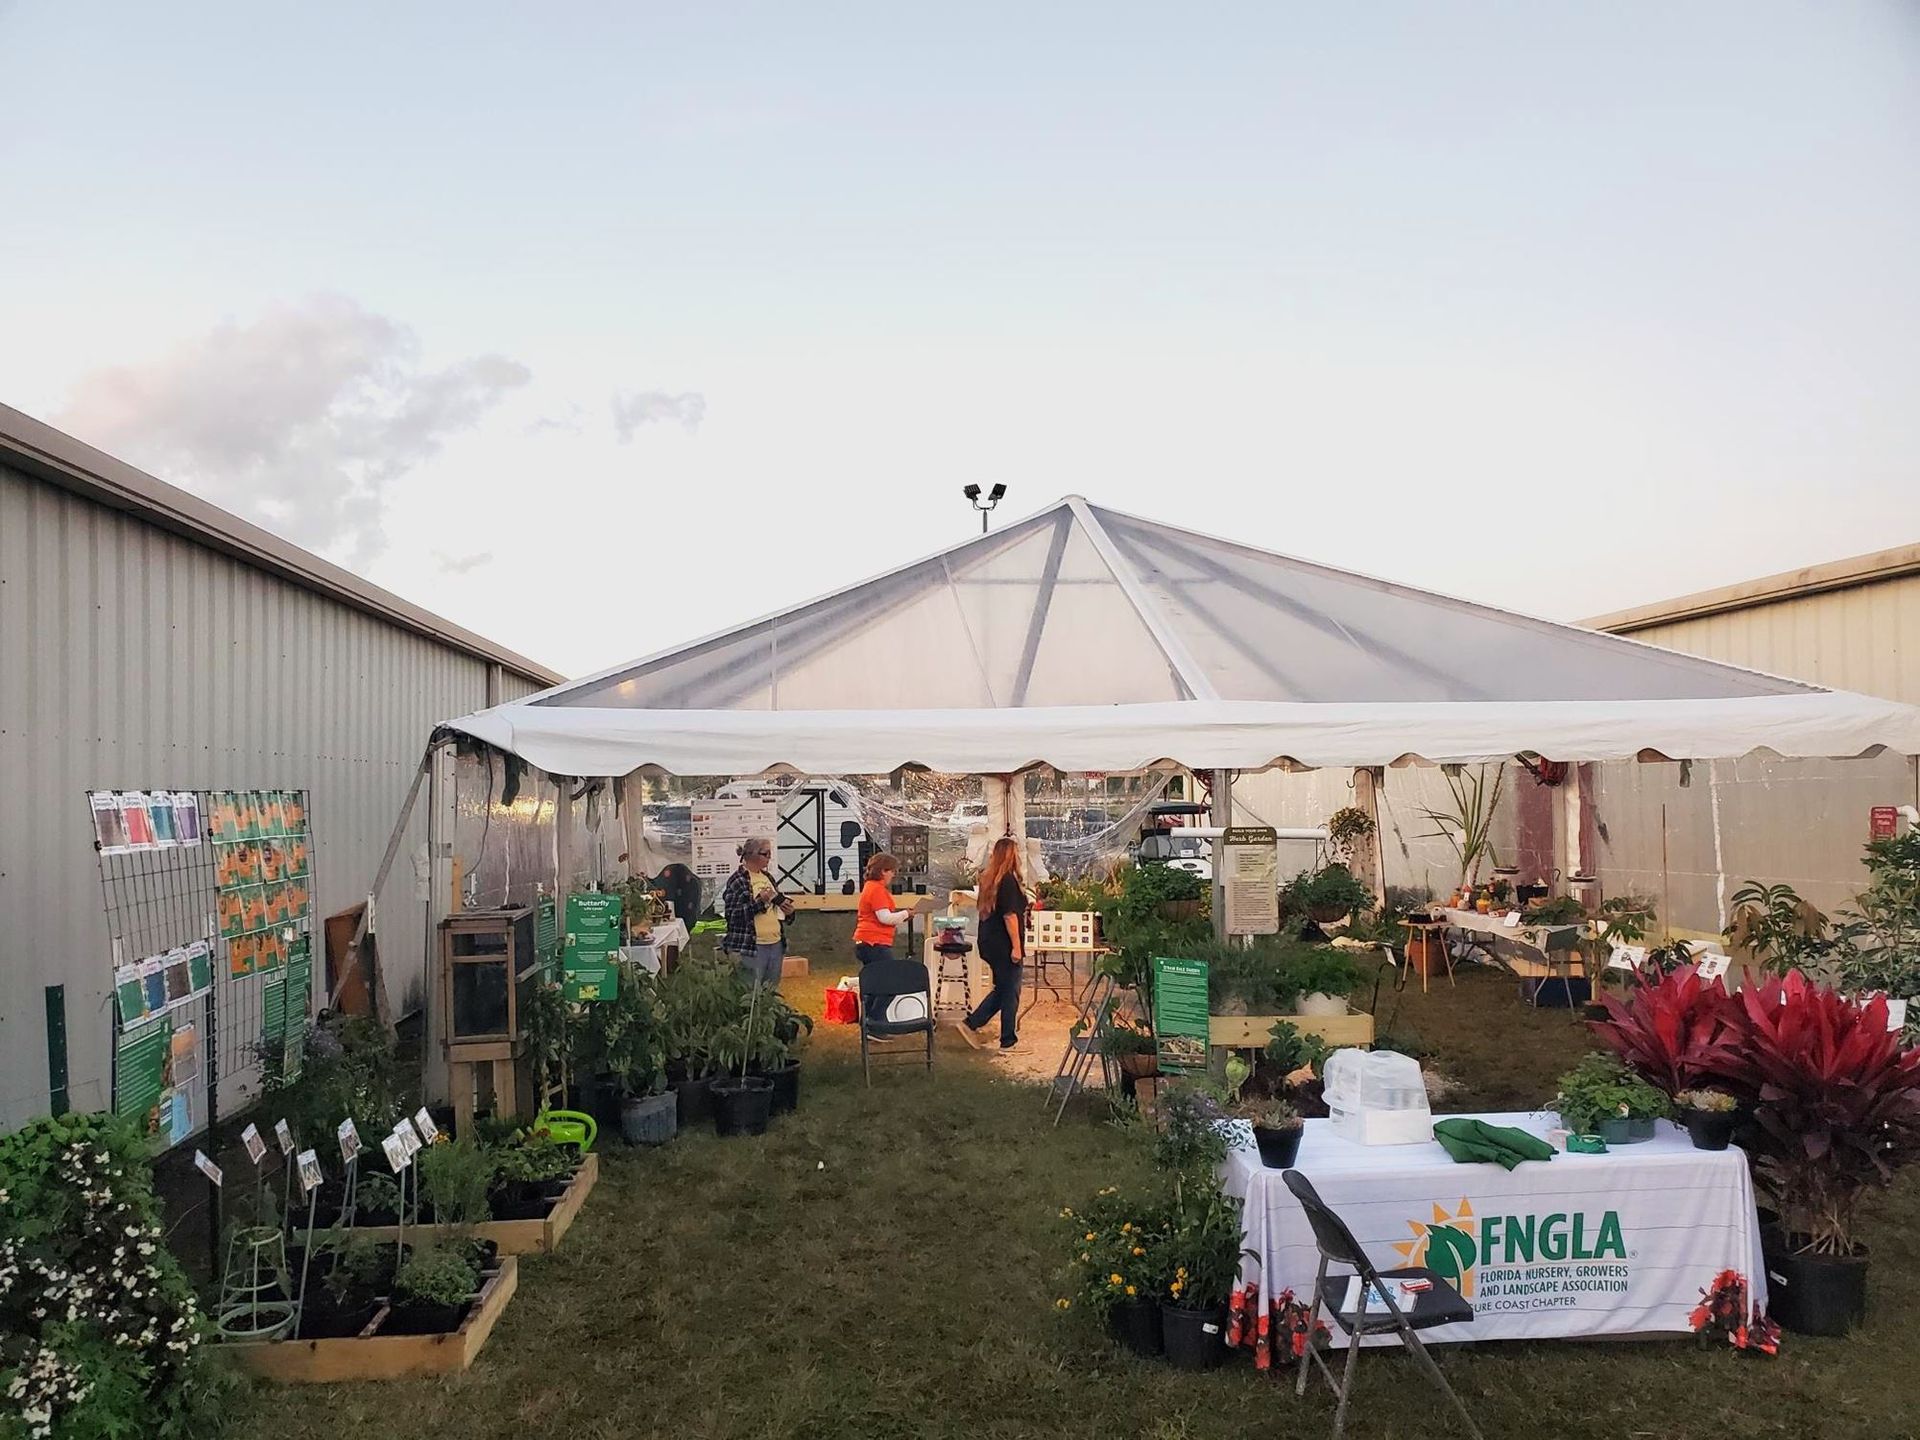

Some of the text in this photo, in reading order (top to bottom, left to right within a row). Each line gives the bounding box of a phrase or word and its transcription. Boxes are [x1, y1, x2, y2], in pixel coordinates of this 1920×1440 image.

[578, 900, 610, 908] Butterfly
[1480, 1210, 1627, 1266] FNGLA
[1480, 1265, 1629, 1284] FLORIDA NURSERY, GROWERS
[1480, 1280, 1629, 1298] AND LANDSCAPE ASSOCIATION
[1494, 1300, 1530, 1310] COAST
[1531, 1296, 1577, 1308] CHAPTER
